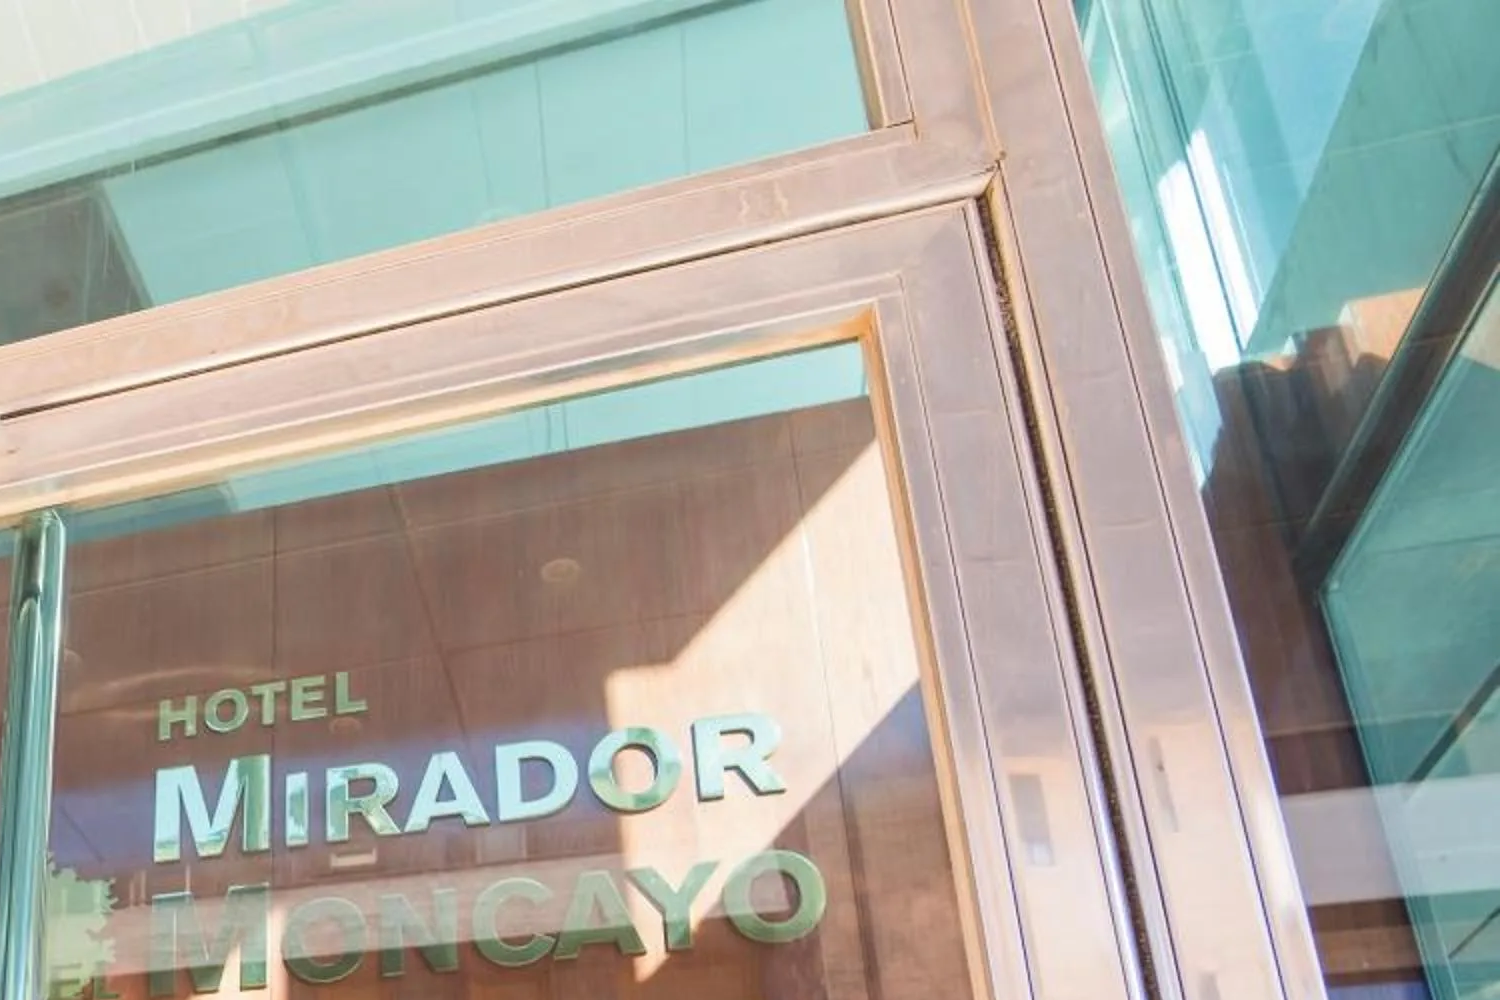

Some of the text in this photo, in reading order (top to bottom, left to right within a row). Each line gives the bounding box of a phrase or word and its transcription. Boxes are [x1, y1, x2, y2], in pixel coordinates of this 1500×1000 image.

[157, 671, 369, 741] HOTEL
[153, 711, 787, 864] MIRADOR
[148, 848, 827, 998] MONCAYO
